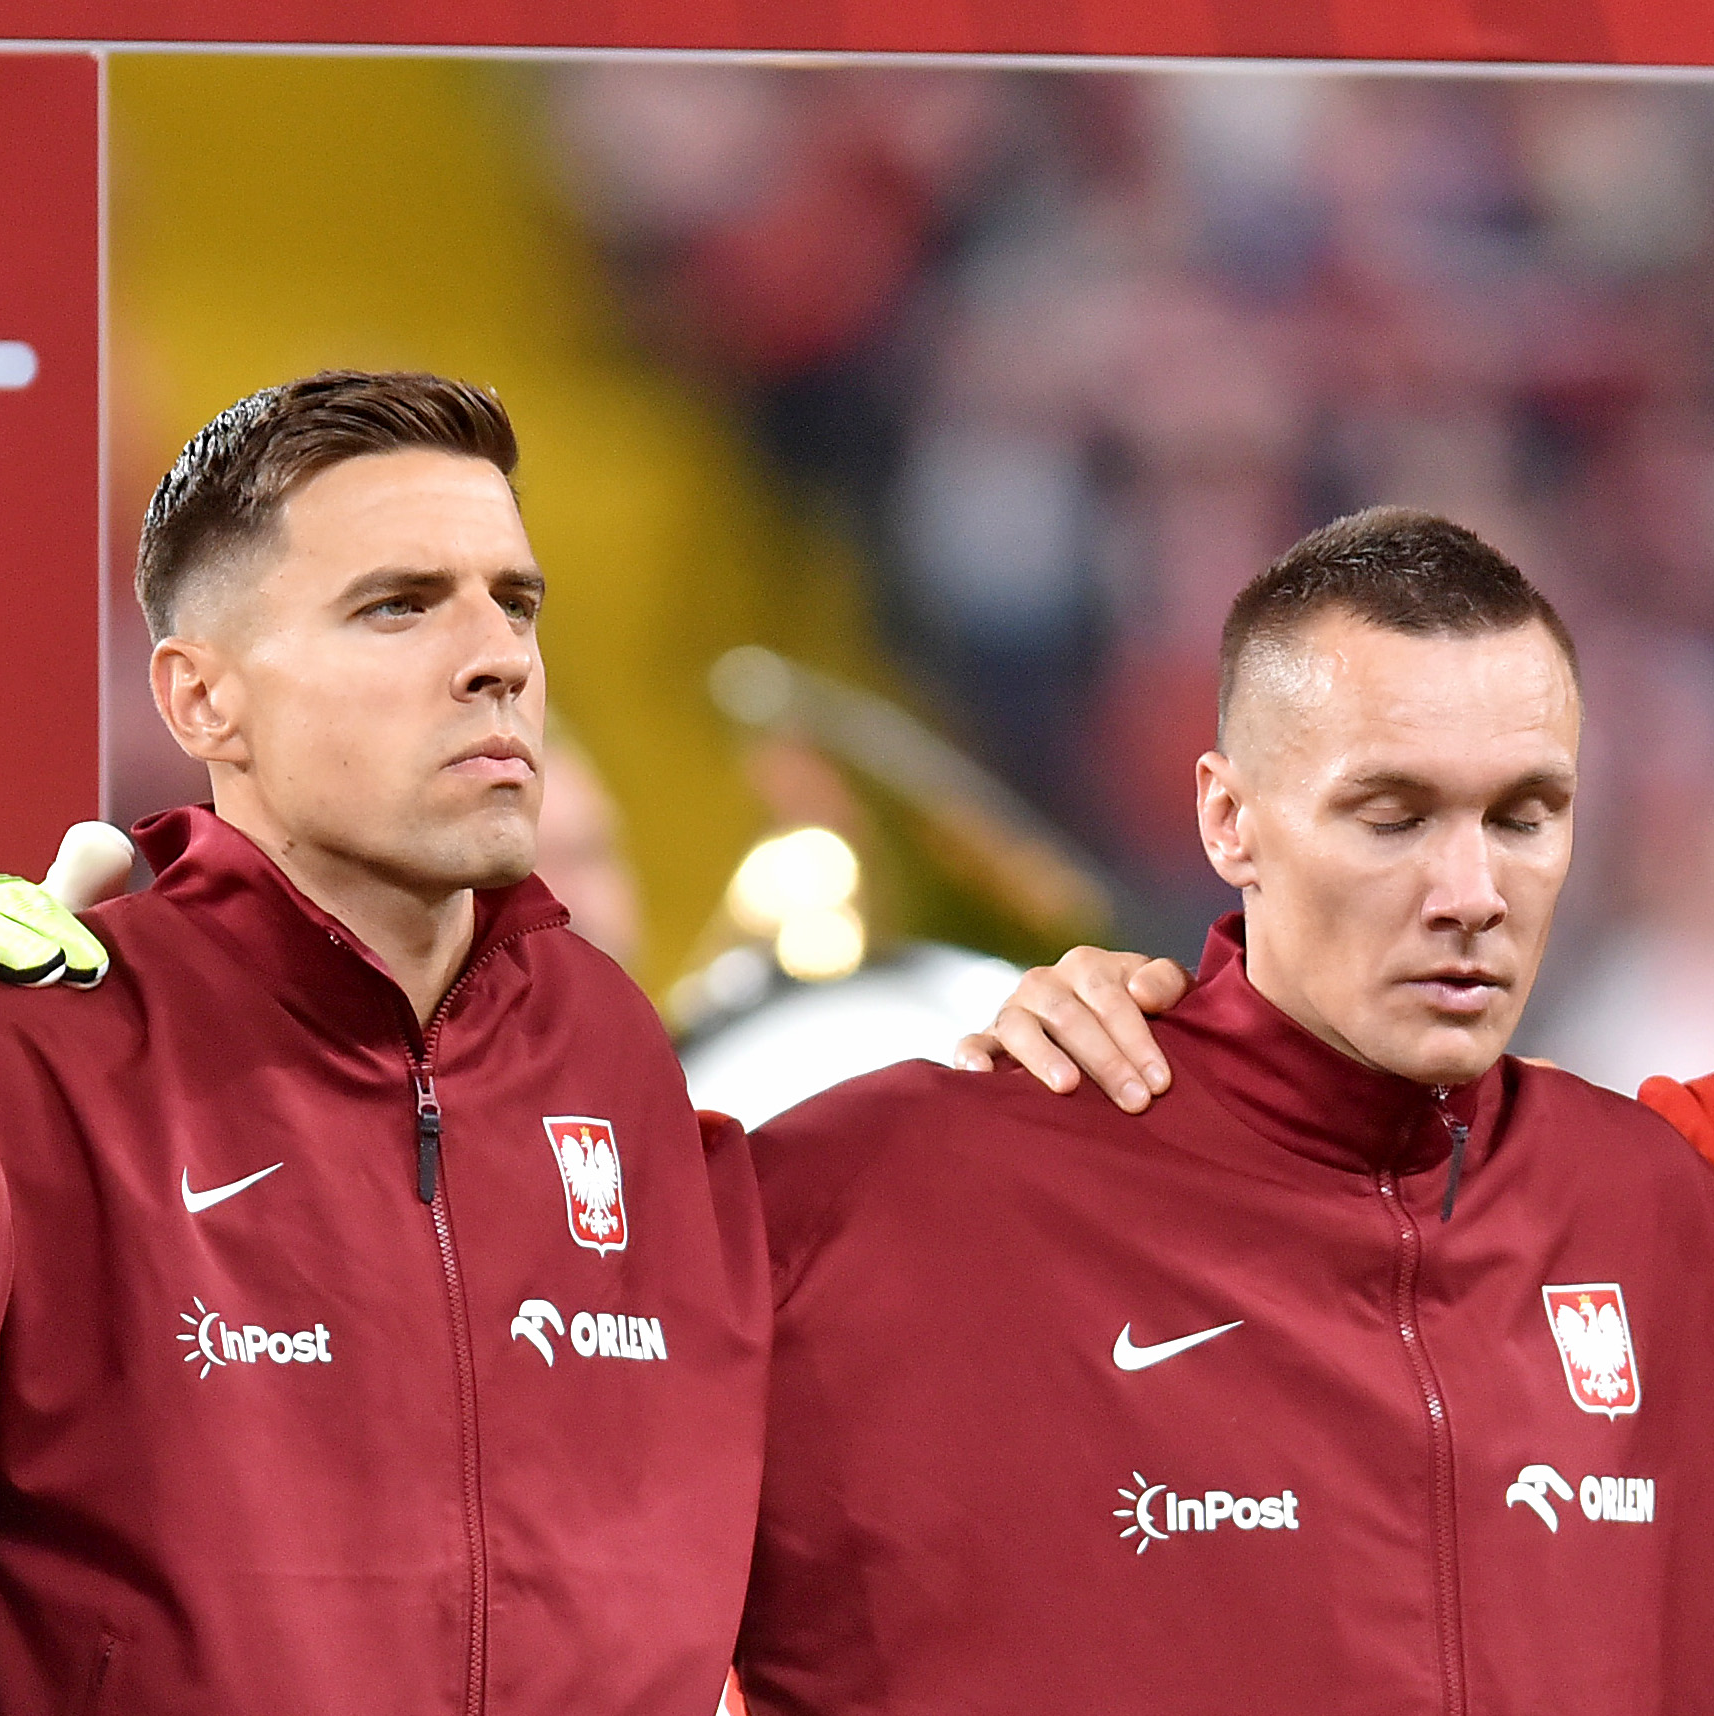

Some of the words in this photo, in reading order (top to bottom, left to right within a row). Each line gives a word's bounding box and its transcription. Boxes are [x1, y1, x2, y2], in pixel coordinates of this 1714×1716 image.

[220, 1321, 333, 1364] InPost
[570, 1311, 668, 1361] ORLEN
[1167, 1489, 1300, 1532] InPost
[1579, 1474, 1656, 1524] ORLEN
